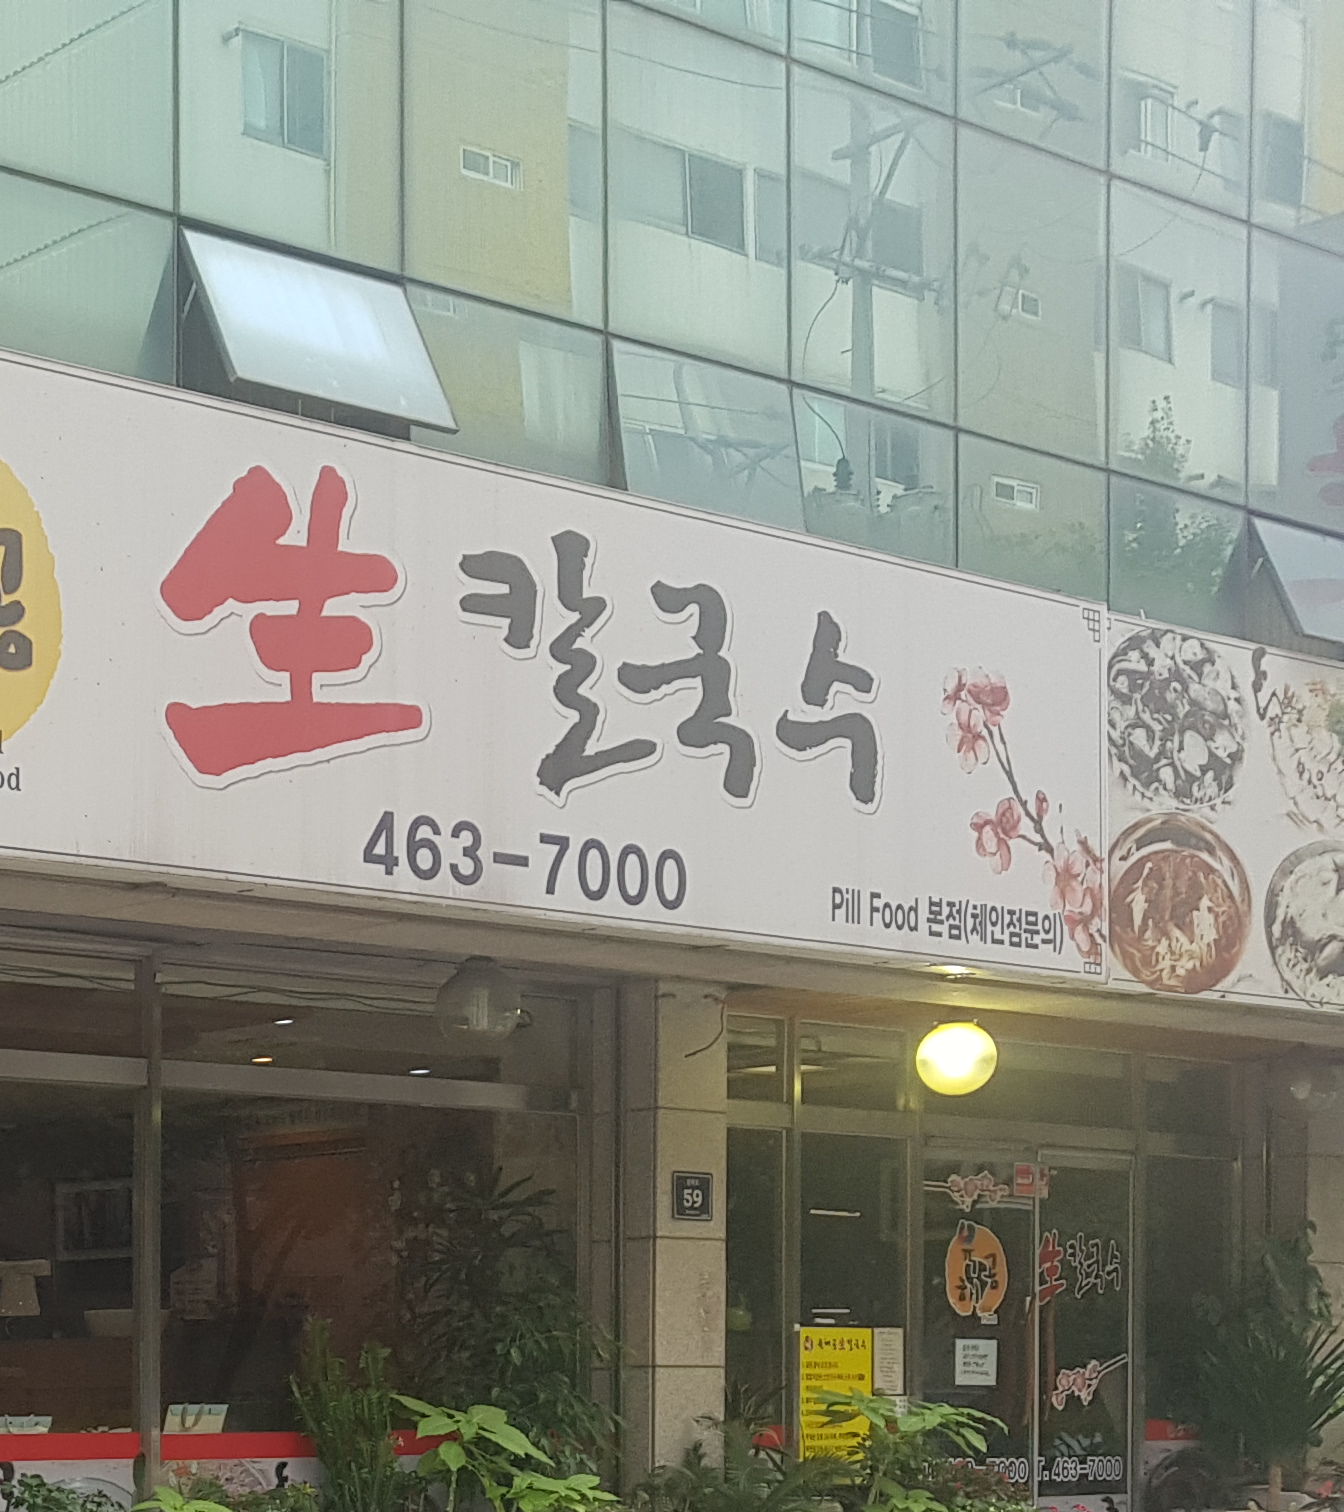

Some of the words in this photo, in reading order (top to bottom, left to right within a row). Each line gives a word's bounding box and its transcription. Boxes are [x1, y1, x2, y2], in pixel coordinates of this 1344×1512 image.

[362, 810, 688, 911] 463-7000
[831, 886, 861, 926] Pill
[869, 892, 919, 933] Food
[683, 1188, 703, 1208] 59
